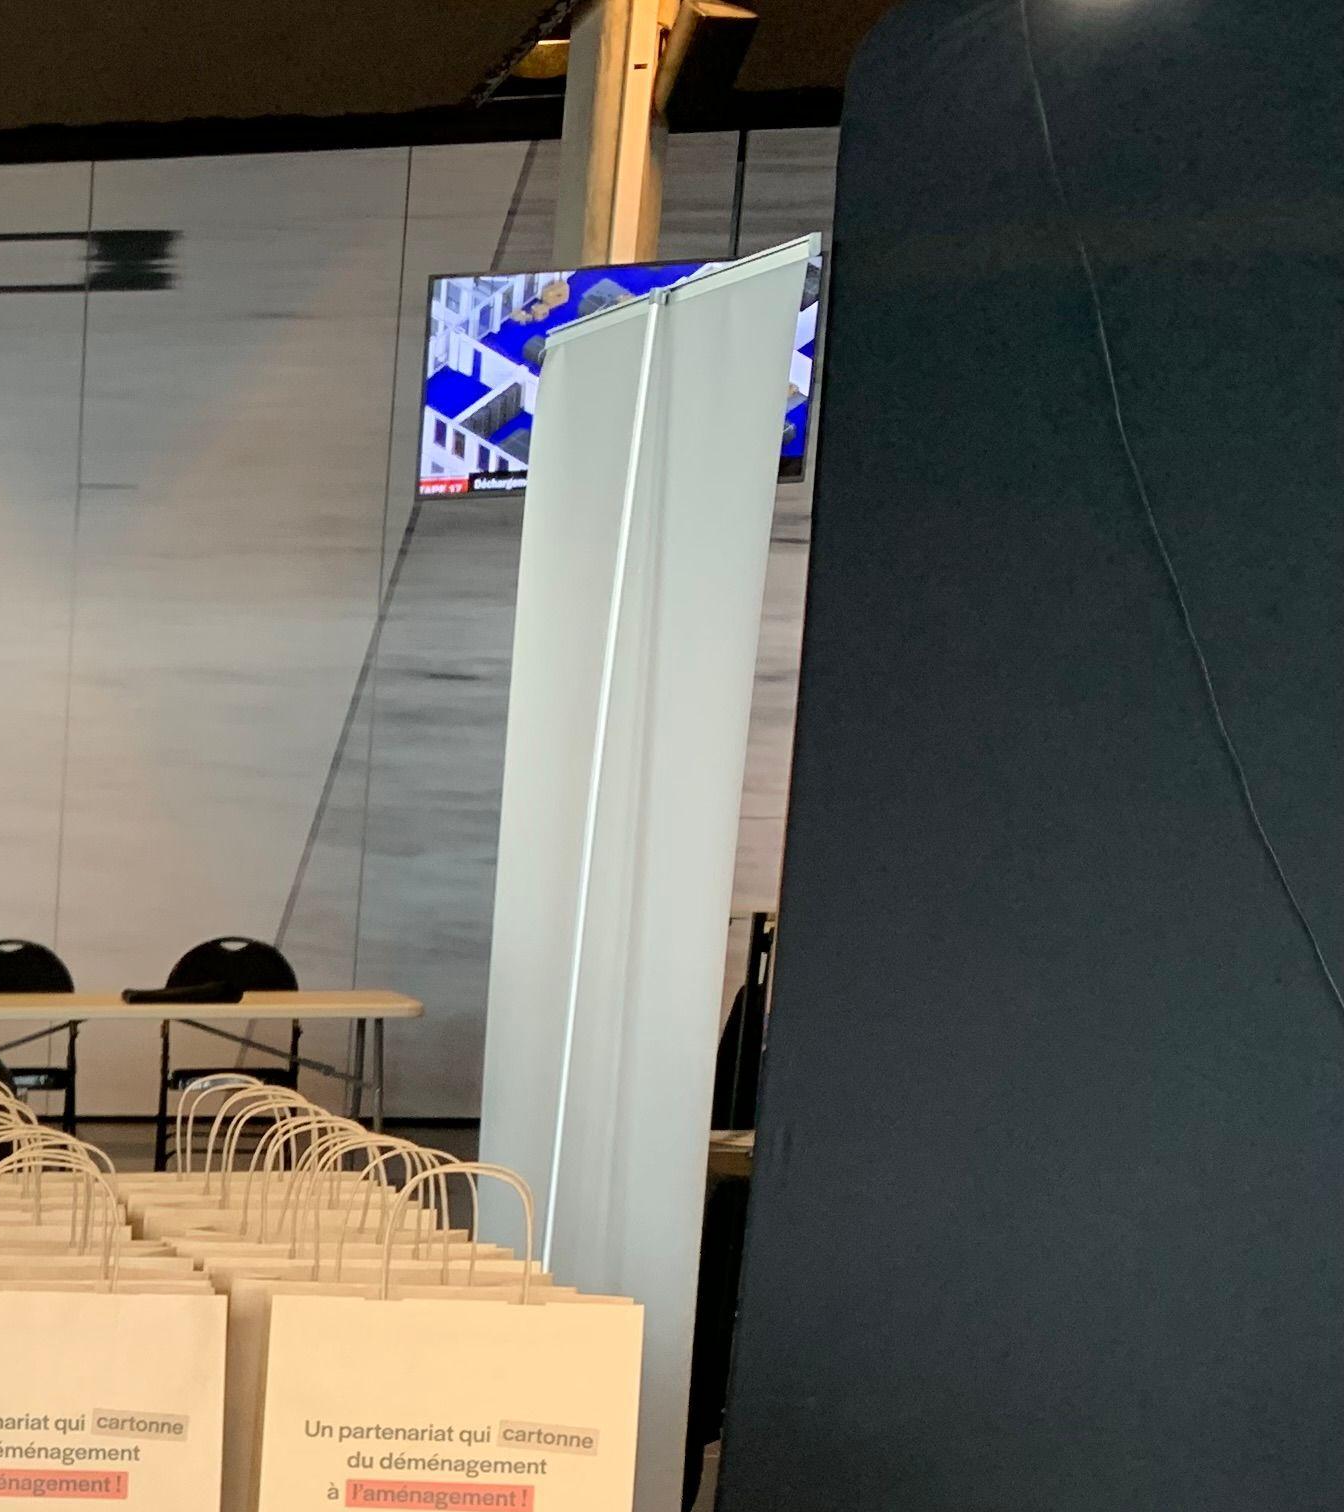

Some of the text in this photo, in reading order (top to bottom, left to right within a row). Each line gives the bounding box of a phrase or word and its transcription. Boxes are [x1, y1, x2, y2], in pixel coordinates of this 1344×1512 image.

[54, 1414, 86, 1436] qui
[96, 1414, 184, 1435] cartonne
[304, 1419, 594, 1449] Un partenariat qui cartonne
[347, 1450, 548, 1477] du déménagement
[327, 1482, 339, 1500] à
[352, 1483, 517, 1509] l'aménagement
